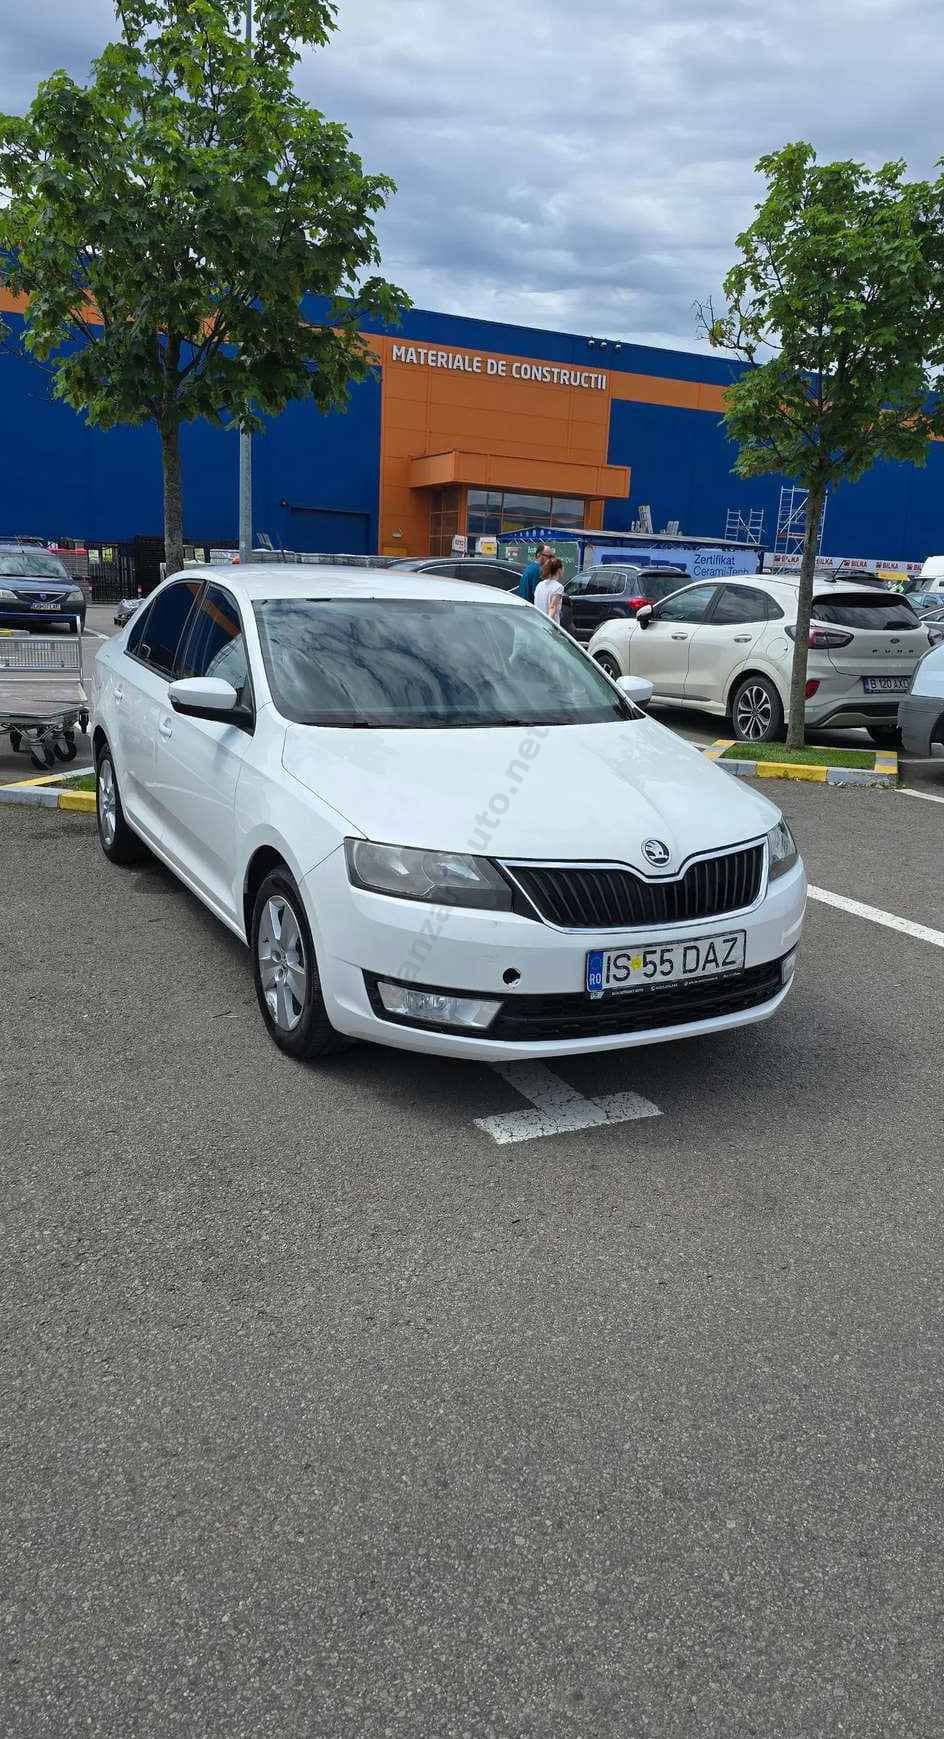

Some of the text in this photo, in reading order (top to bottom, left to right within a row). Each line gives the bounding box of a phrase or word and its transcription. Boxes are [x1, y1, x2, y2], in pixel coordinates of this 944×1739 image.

[392, 345, 607, 389] MATERIALE DE CONSTRUCTII
[694, 554, 735, 565] Zertifikat
[851, 560, 868, 568] BILKA
[882, 561, 898, 569] BILKA
[605, 937, 738, 984] IS 55 DAZ
[589, 973, 602, 985] RO
